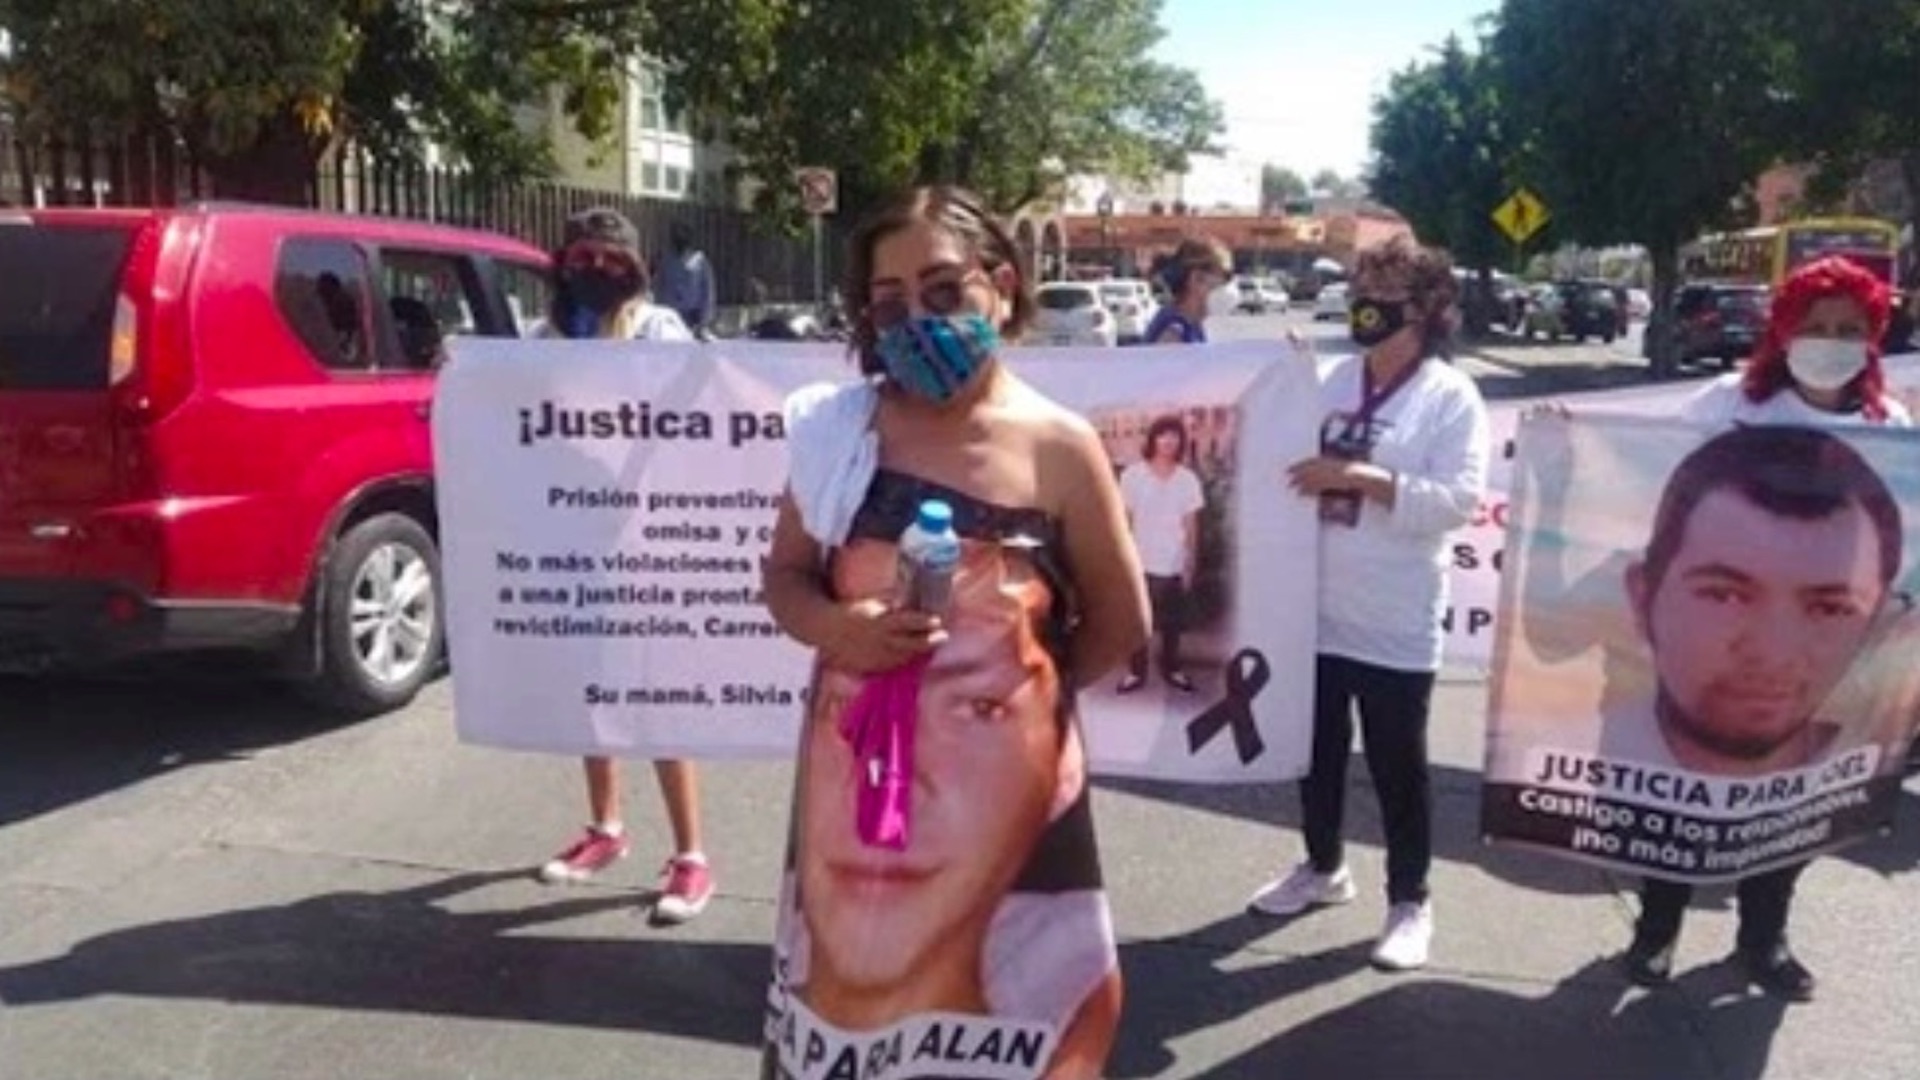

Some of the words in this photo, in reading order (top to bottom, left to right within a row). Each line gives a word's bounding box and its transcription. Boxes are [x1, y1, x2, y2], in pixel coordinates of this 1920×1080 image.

[518, 402, 713, 446] ¡Justica
[548, 487, 640, 509] Prisión
[642, 521, 722, 542] omisa
[735, 525, 749, 546] y
[497, 552, 531, 573] No
[539, 551, 596, 573] más
[602, 551, 752, 574] violaciones
[498, 587, 514, 604] a
[520, 588, 570, 604] una
[575, 584, 676, 608] justicia
[494, 615, 697, 639] revictimización,
[585, 684, 619, 705] Su
[625, 683, 714, 707] mamá,
[721, 684, 793, 705] Silvia
[1537, 754, 1712, 808] JUSTICIA
[1726, 775, 1805, 810] PARA
[1643, 814, 1665, 834] a
[1674, 816, 1718, 842] los
[1628, 838, 1696, 869] más
[914, 1022, 1045, 1068] ALAN
